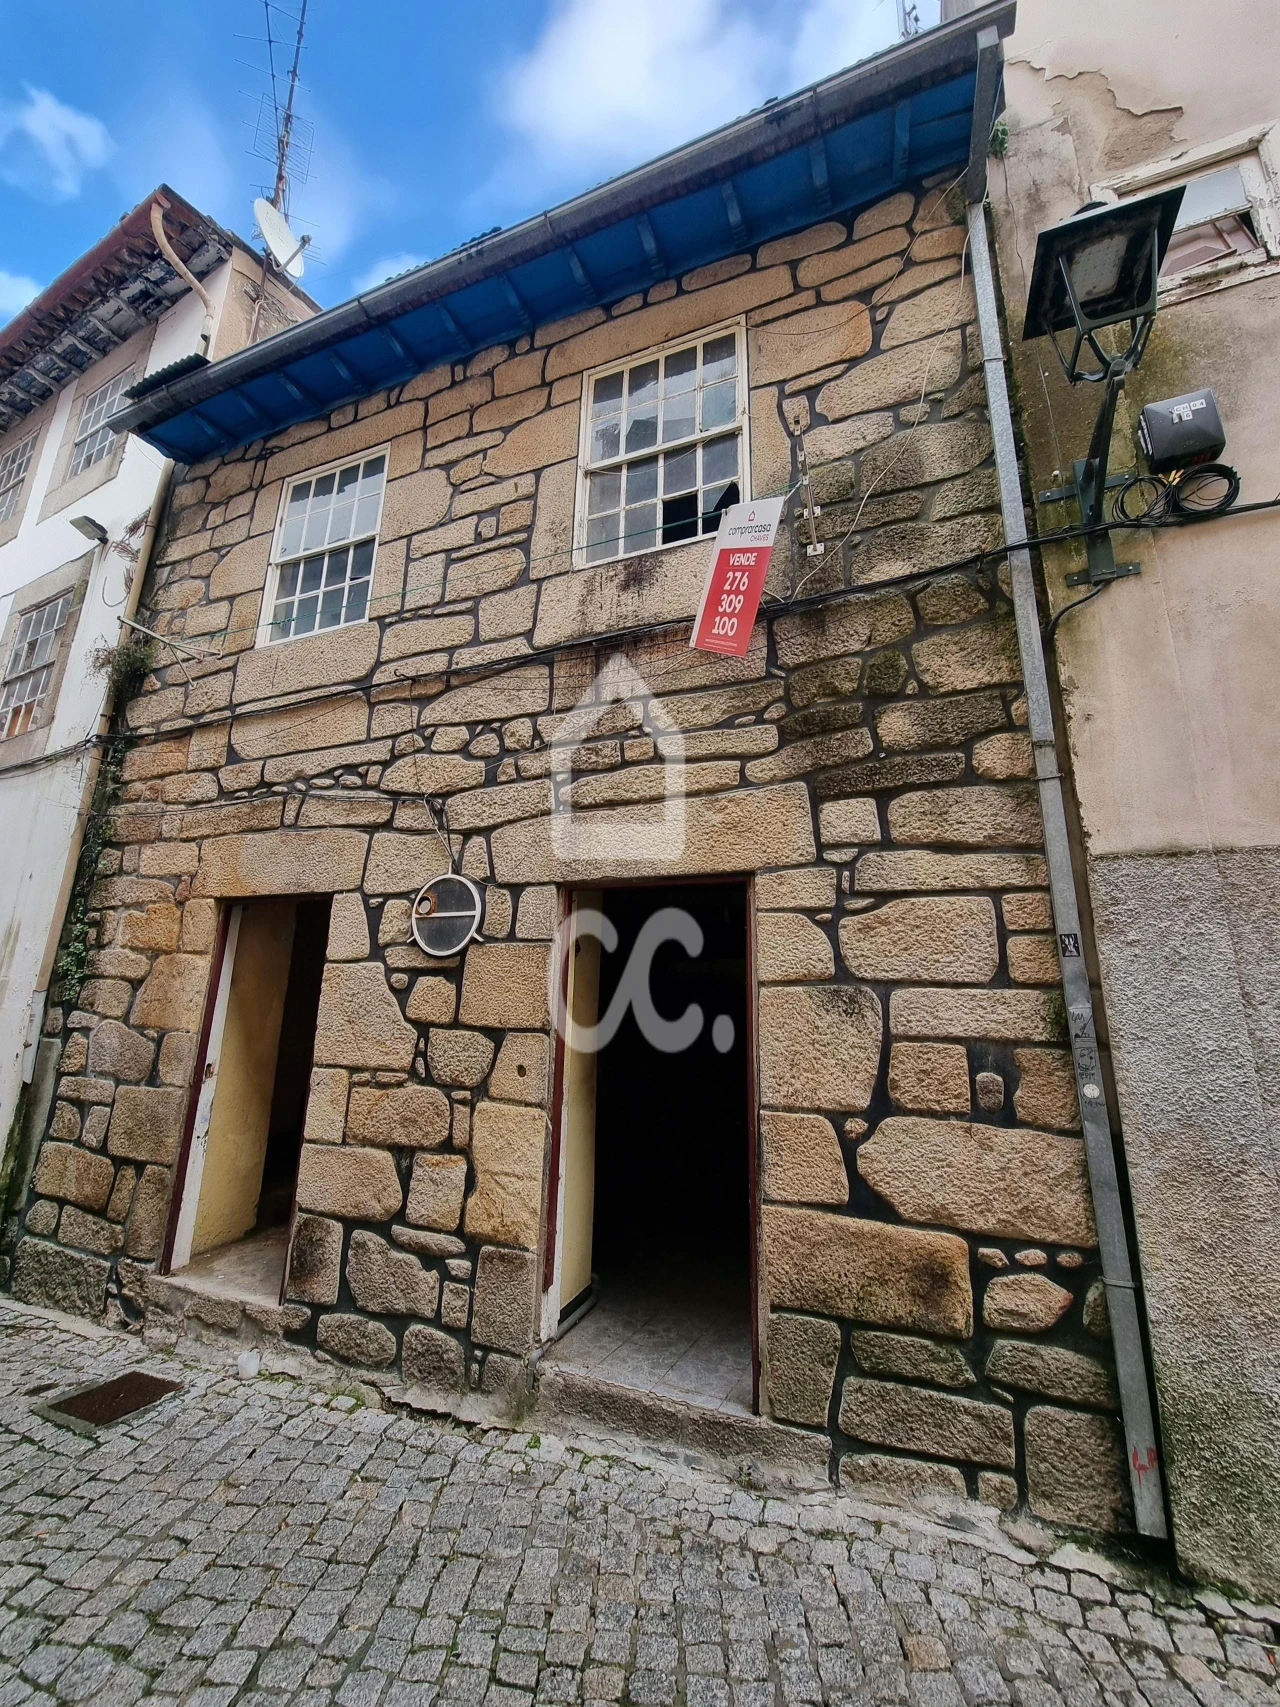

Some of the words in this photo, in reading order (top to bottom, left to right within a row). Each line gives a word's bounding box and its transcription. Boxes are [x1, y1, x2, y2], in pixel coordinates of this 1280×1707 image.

[728, 523, 772, 538] comprarcasa
[729, 552, 757, 566] VENDE
[723, 571, 749, 592] 276
[718, 594, 744, 614] 309
[711, 616, 738, 637] 100
